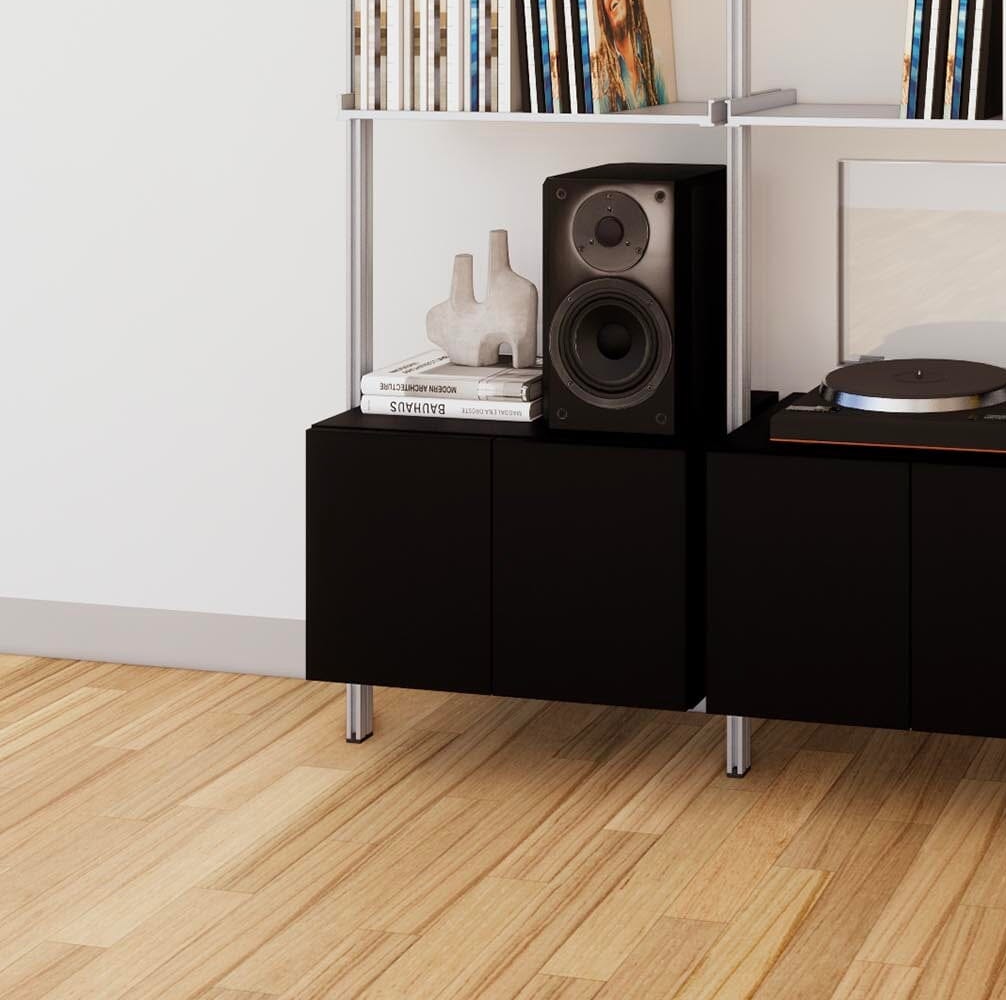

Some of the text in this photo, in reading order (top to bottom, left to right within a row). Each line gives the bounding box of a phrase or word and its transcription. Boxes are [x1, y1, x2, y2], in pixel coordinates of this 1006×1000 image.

[379, 382, 457, 394] MODERN ARCHITECTURE
[389, 401, 445, 415] BAUHAUS
